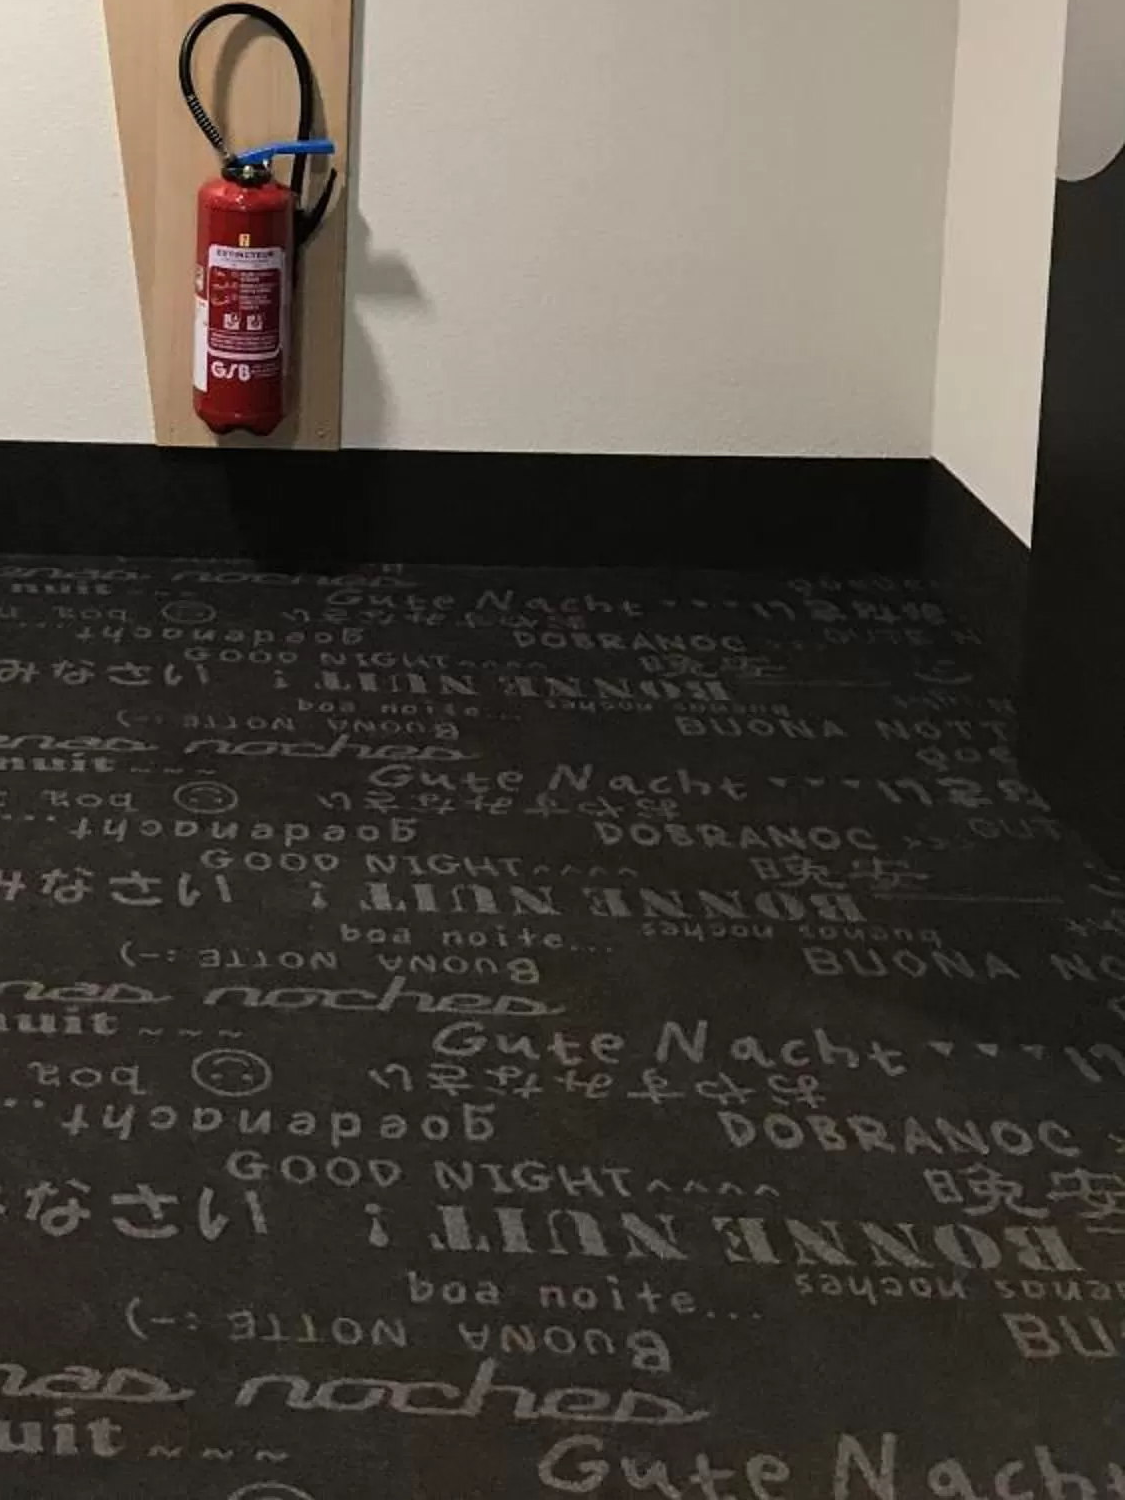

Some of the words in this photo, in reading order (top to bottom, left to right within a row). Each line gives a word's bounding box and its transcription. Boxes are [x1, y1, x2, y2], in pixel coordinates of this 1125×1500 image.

[593, 821, 878, 851] DOBRANOC
[200, 848, 340, 872] GOOD
[801, 946, 1021, 981] BUONA
[430, 1020, 625, 1066] Gute
[655, 1019, 909, 1078] Nacht
[717, 1111, 1083, 1157] DOBRANOC
[225, 1150, 402, 1190] GOOD
[433, 1159, 633, 1199] NIGHT
